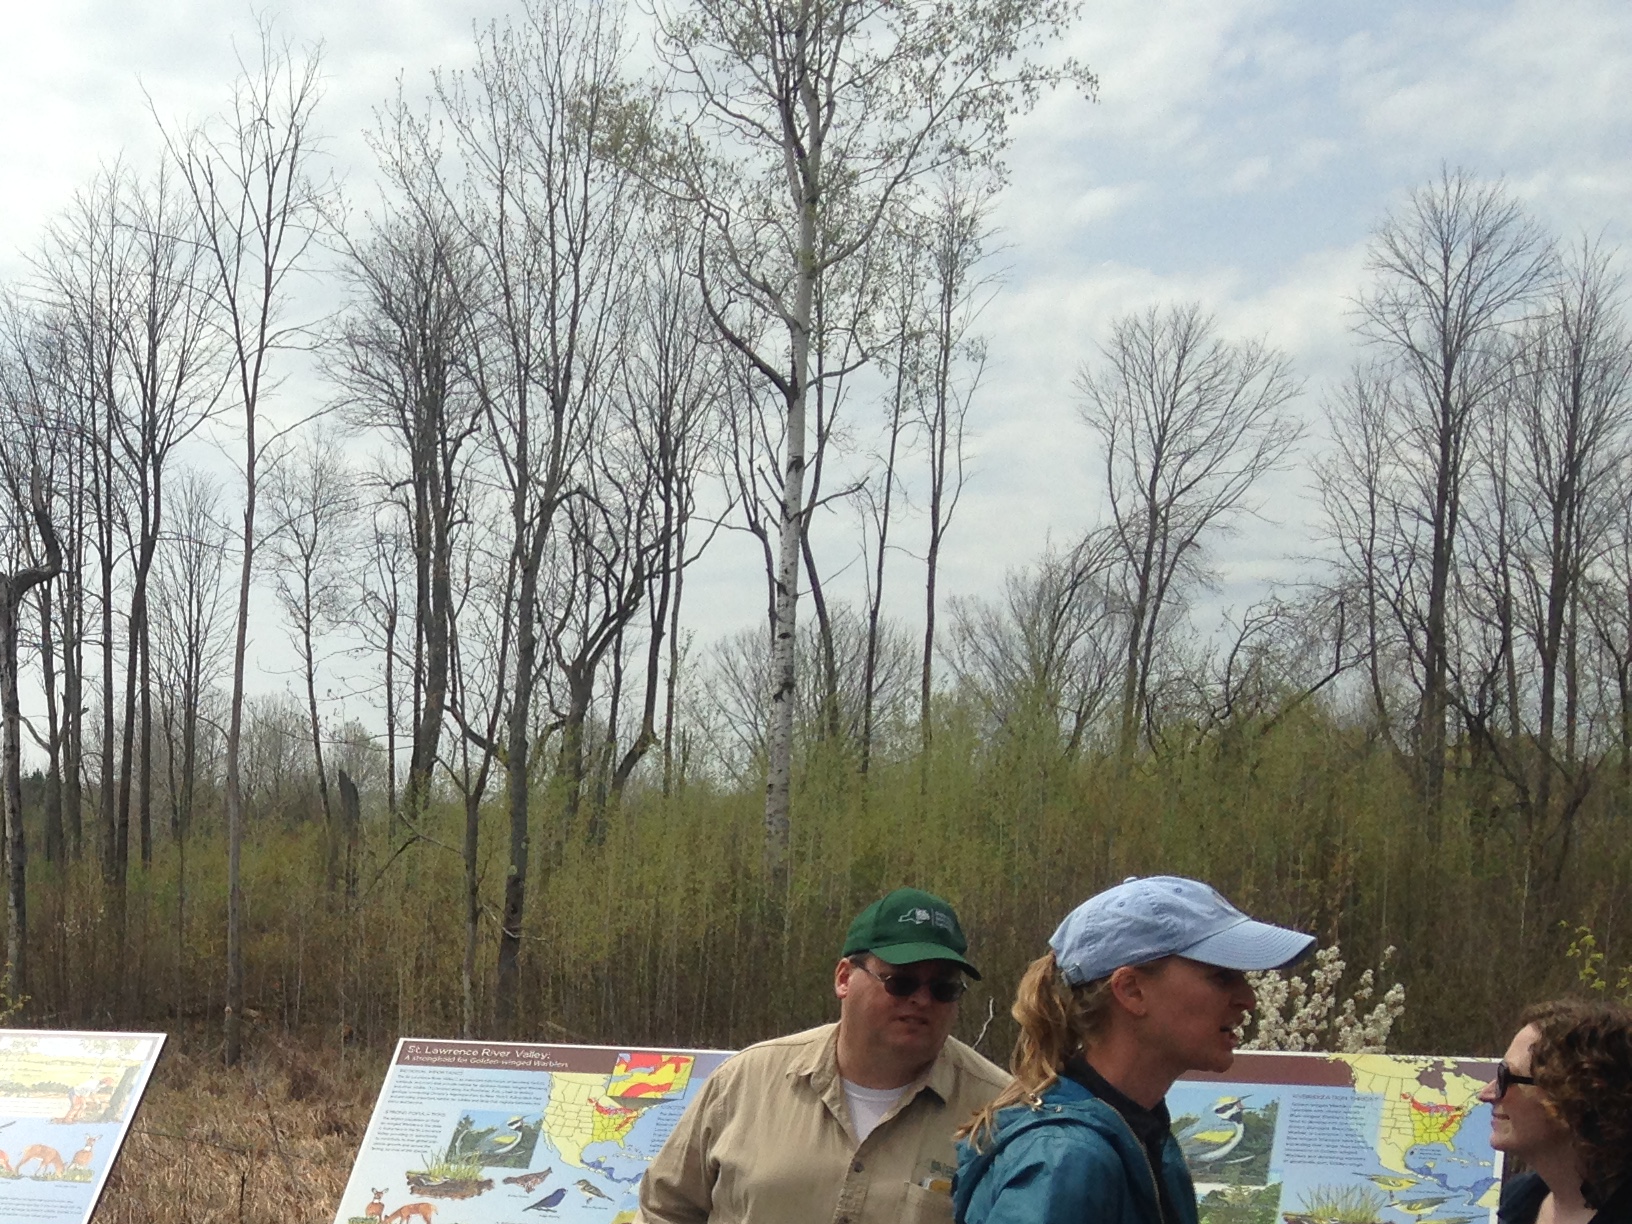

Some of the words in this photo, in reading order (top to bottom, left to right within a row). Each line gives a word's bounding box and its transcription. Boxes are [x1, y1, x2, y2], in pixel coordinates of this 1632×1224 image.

[424, 1046, 479, 1057] Lawrence
[481, 1048, 511, 1058] River
[514, 1050, 552, 1060] Valley:
